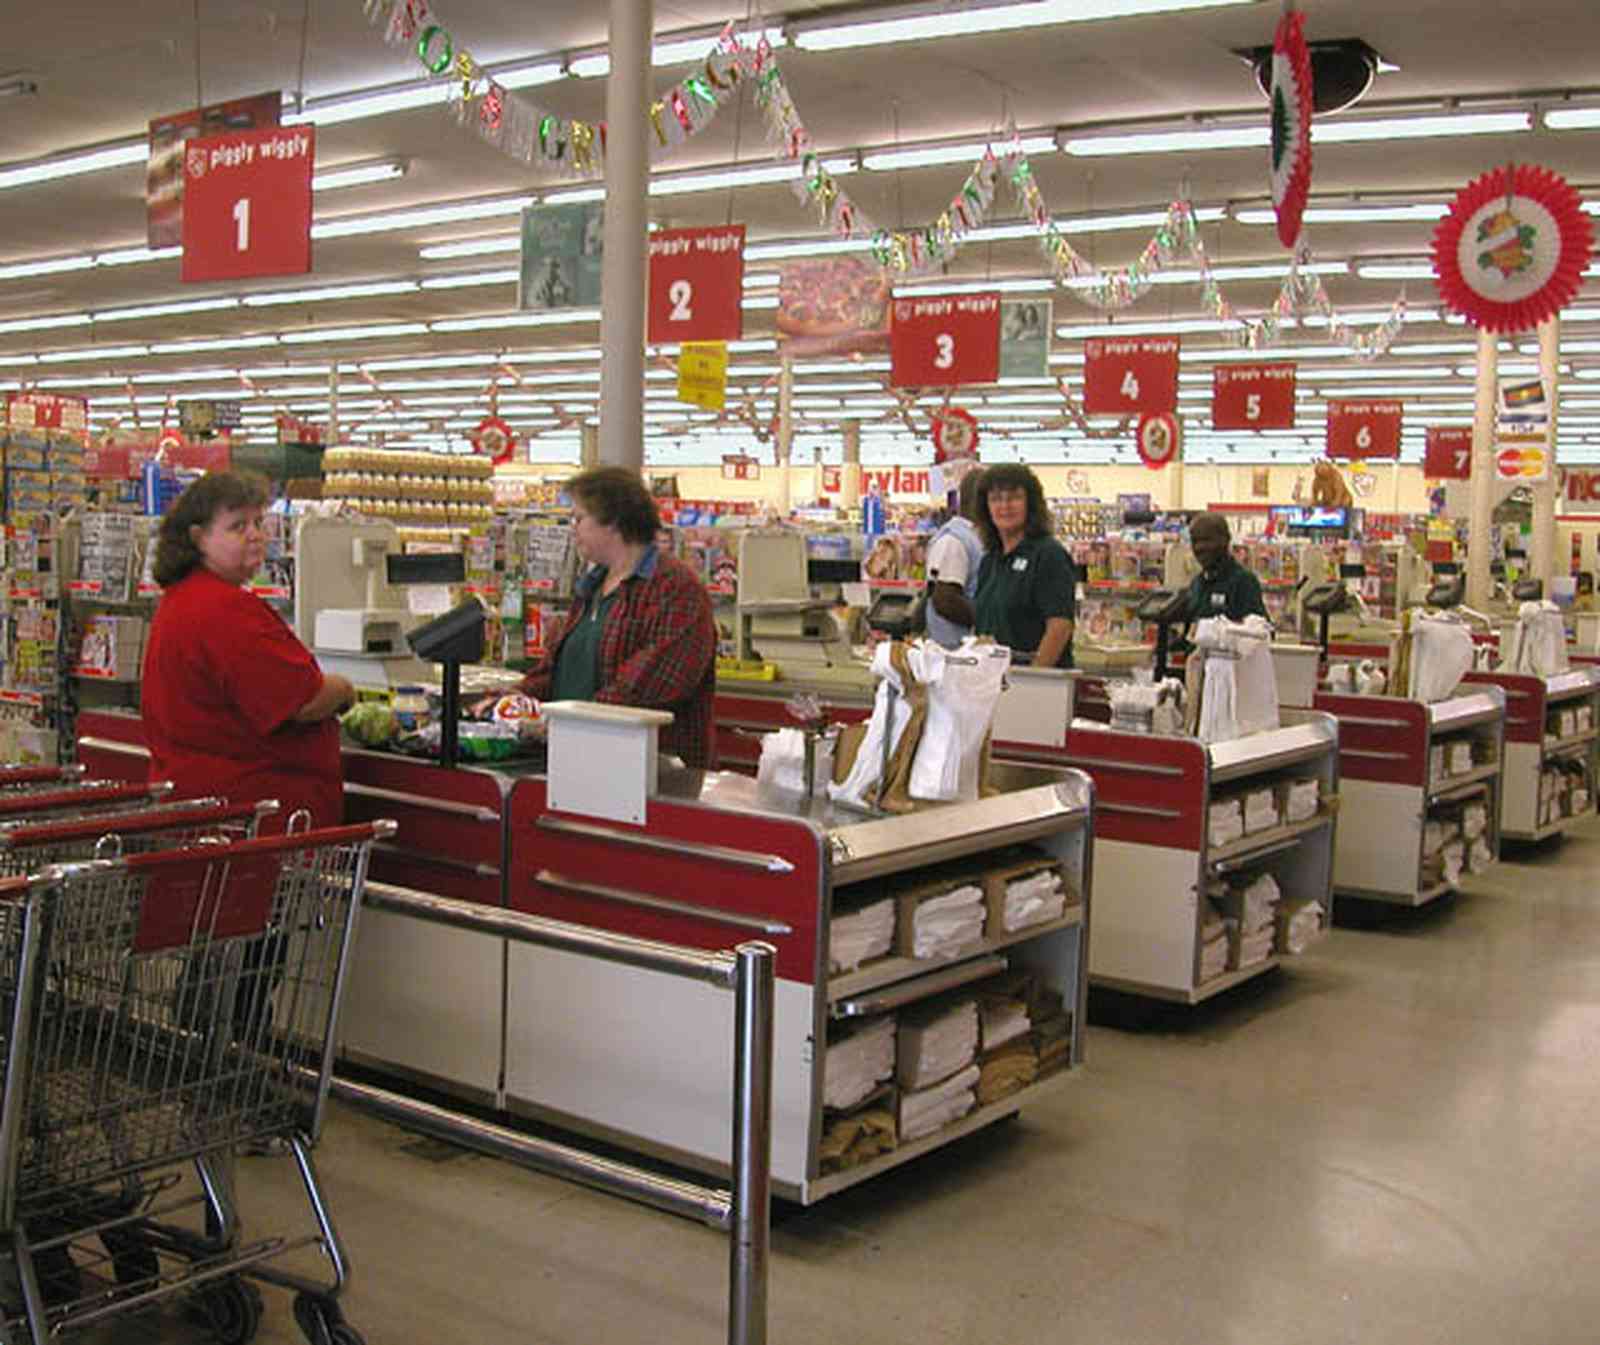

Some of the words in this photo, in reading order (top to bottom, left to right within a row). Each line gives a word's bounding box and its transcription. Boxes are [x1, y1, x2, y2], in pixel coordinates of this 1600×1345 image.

[211, 141, 254, 170] piggly
[260, 134, 309, 159] wiggly
[233, 199, 249, 251] 1
[696, 232, 740, 252] wiggly
[669, 280, 691, 320] 2
[914, 300, 952, 316] piggly
[957, 297, 998, 312] wiggly
[933, 333, 954, 369] 3
[1120, 371, 1139, 400] 4
[1245, 394, 1261, 419] 5
[1356, 425, 1372, 449] 6
[1455, 450, 1468, 470] 7
